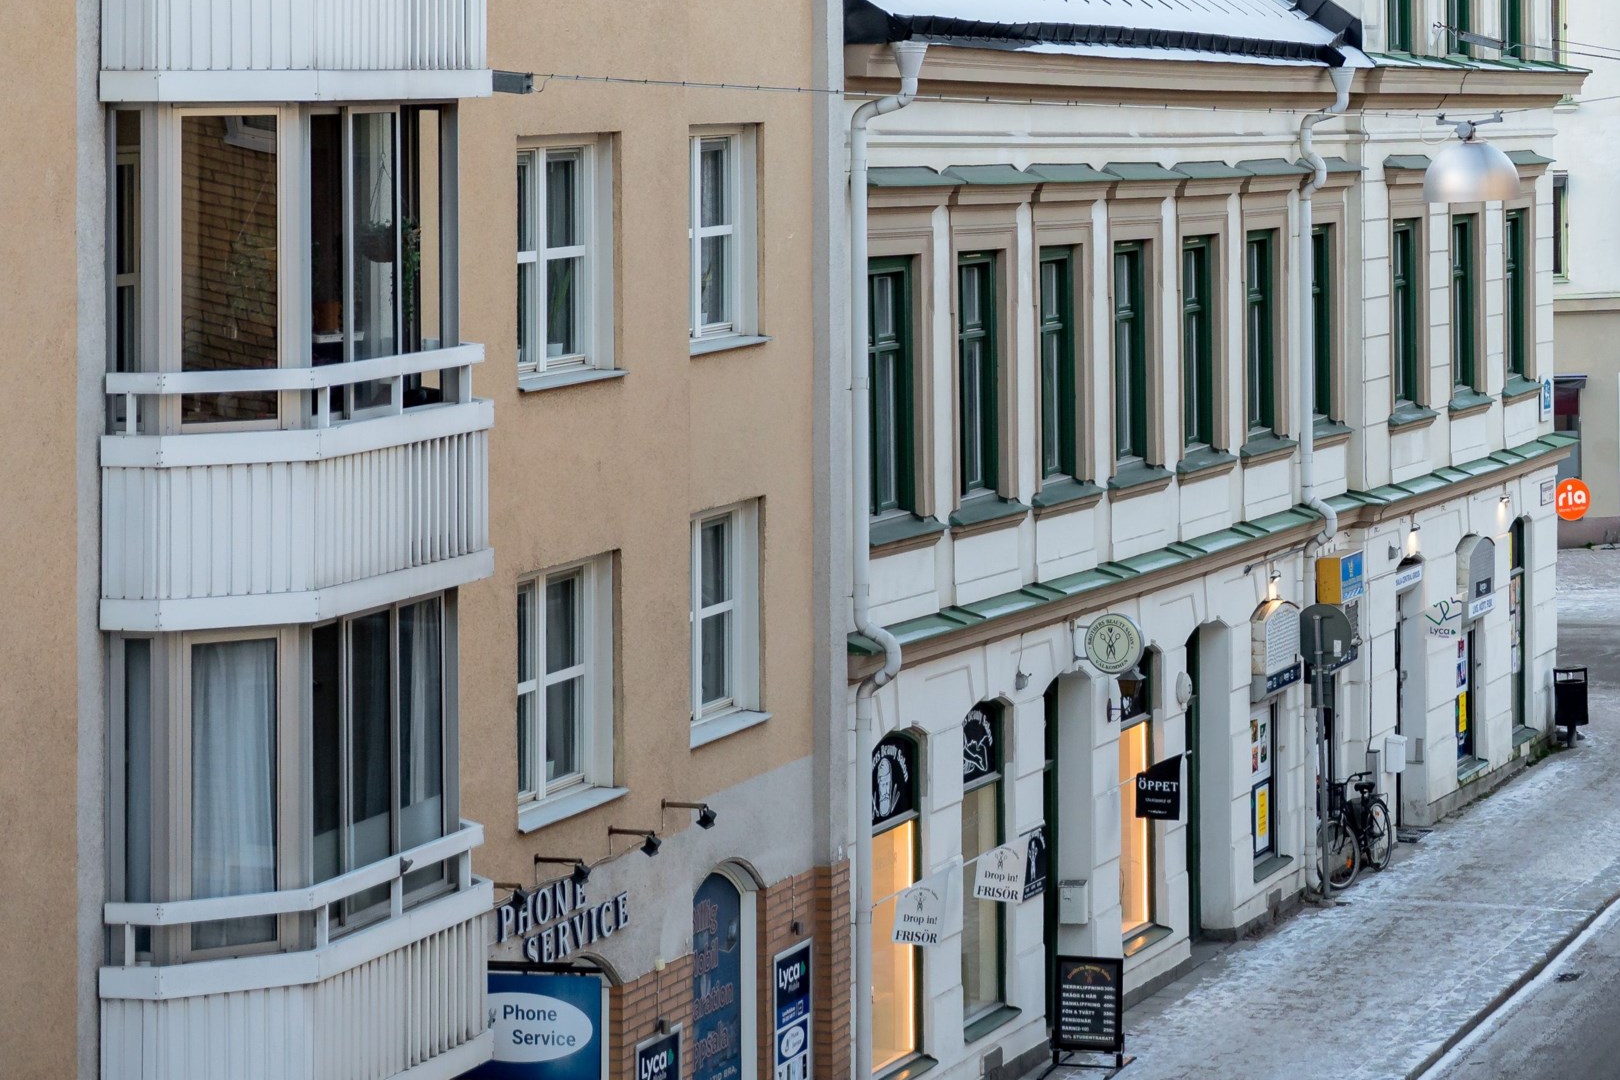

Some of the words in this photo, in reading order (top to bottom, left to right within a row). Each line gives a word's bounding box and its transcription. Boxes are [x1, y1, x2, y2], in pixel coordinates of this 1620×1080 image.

[1558, 484, 1587, 507] ria
[1106, 619, 1126, 629] BEAUTY
[1429, 627, 1450, 637] Lyca
[1138, 777, 1179, 792] ÖPPET
[983, 870, 1006, 883] Drop
[1007, 873, 1019, 883] in!
[976, 885, 1019, 901] FRISÖR
[497, 879, 587, 943] PHONE
[522, 890, 630, 963] SERVICE
[903, 913, 925, 926] Drop
[926, 916, 938, 926] in!
[895, 929, 938, 945] FRISÖR
[778, 962, 801, 990] Lyca
[503, 1004, 557, 1021] Phone
[512, 1028, 576, 1047] Service
[641, 1051, 668, 1080] Lyca
